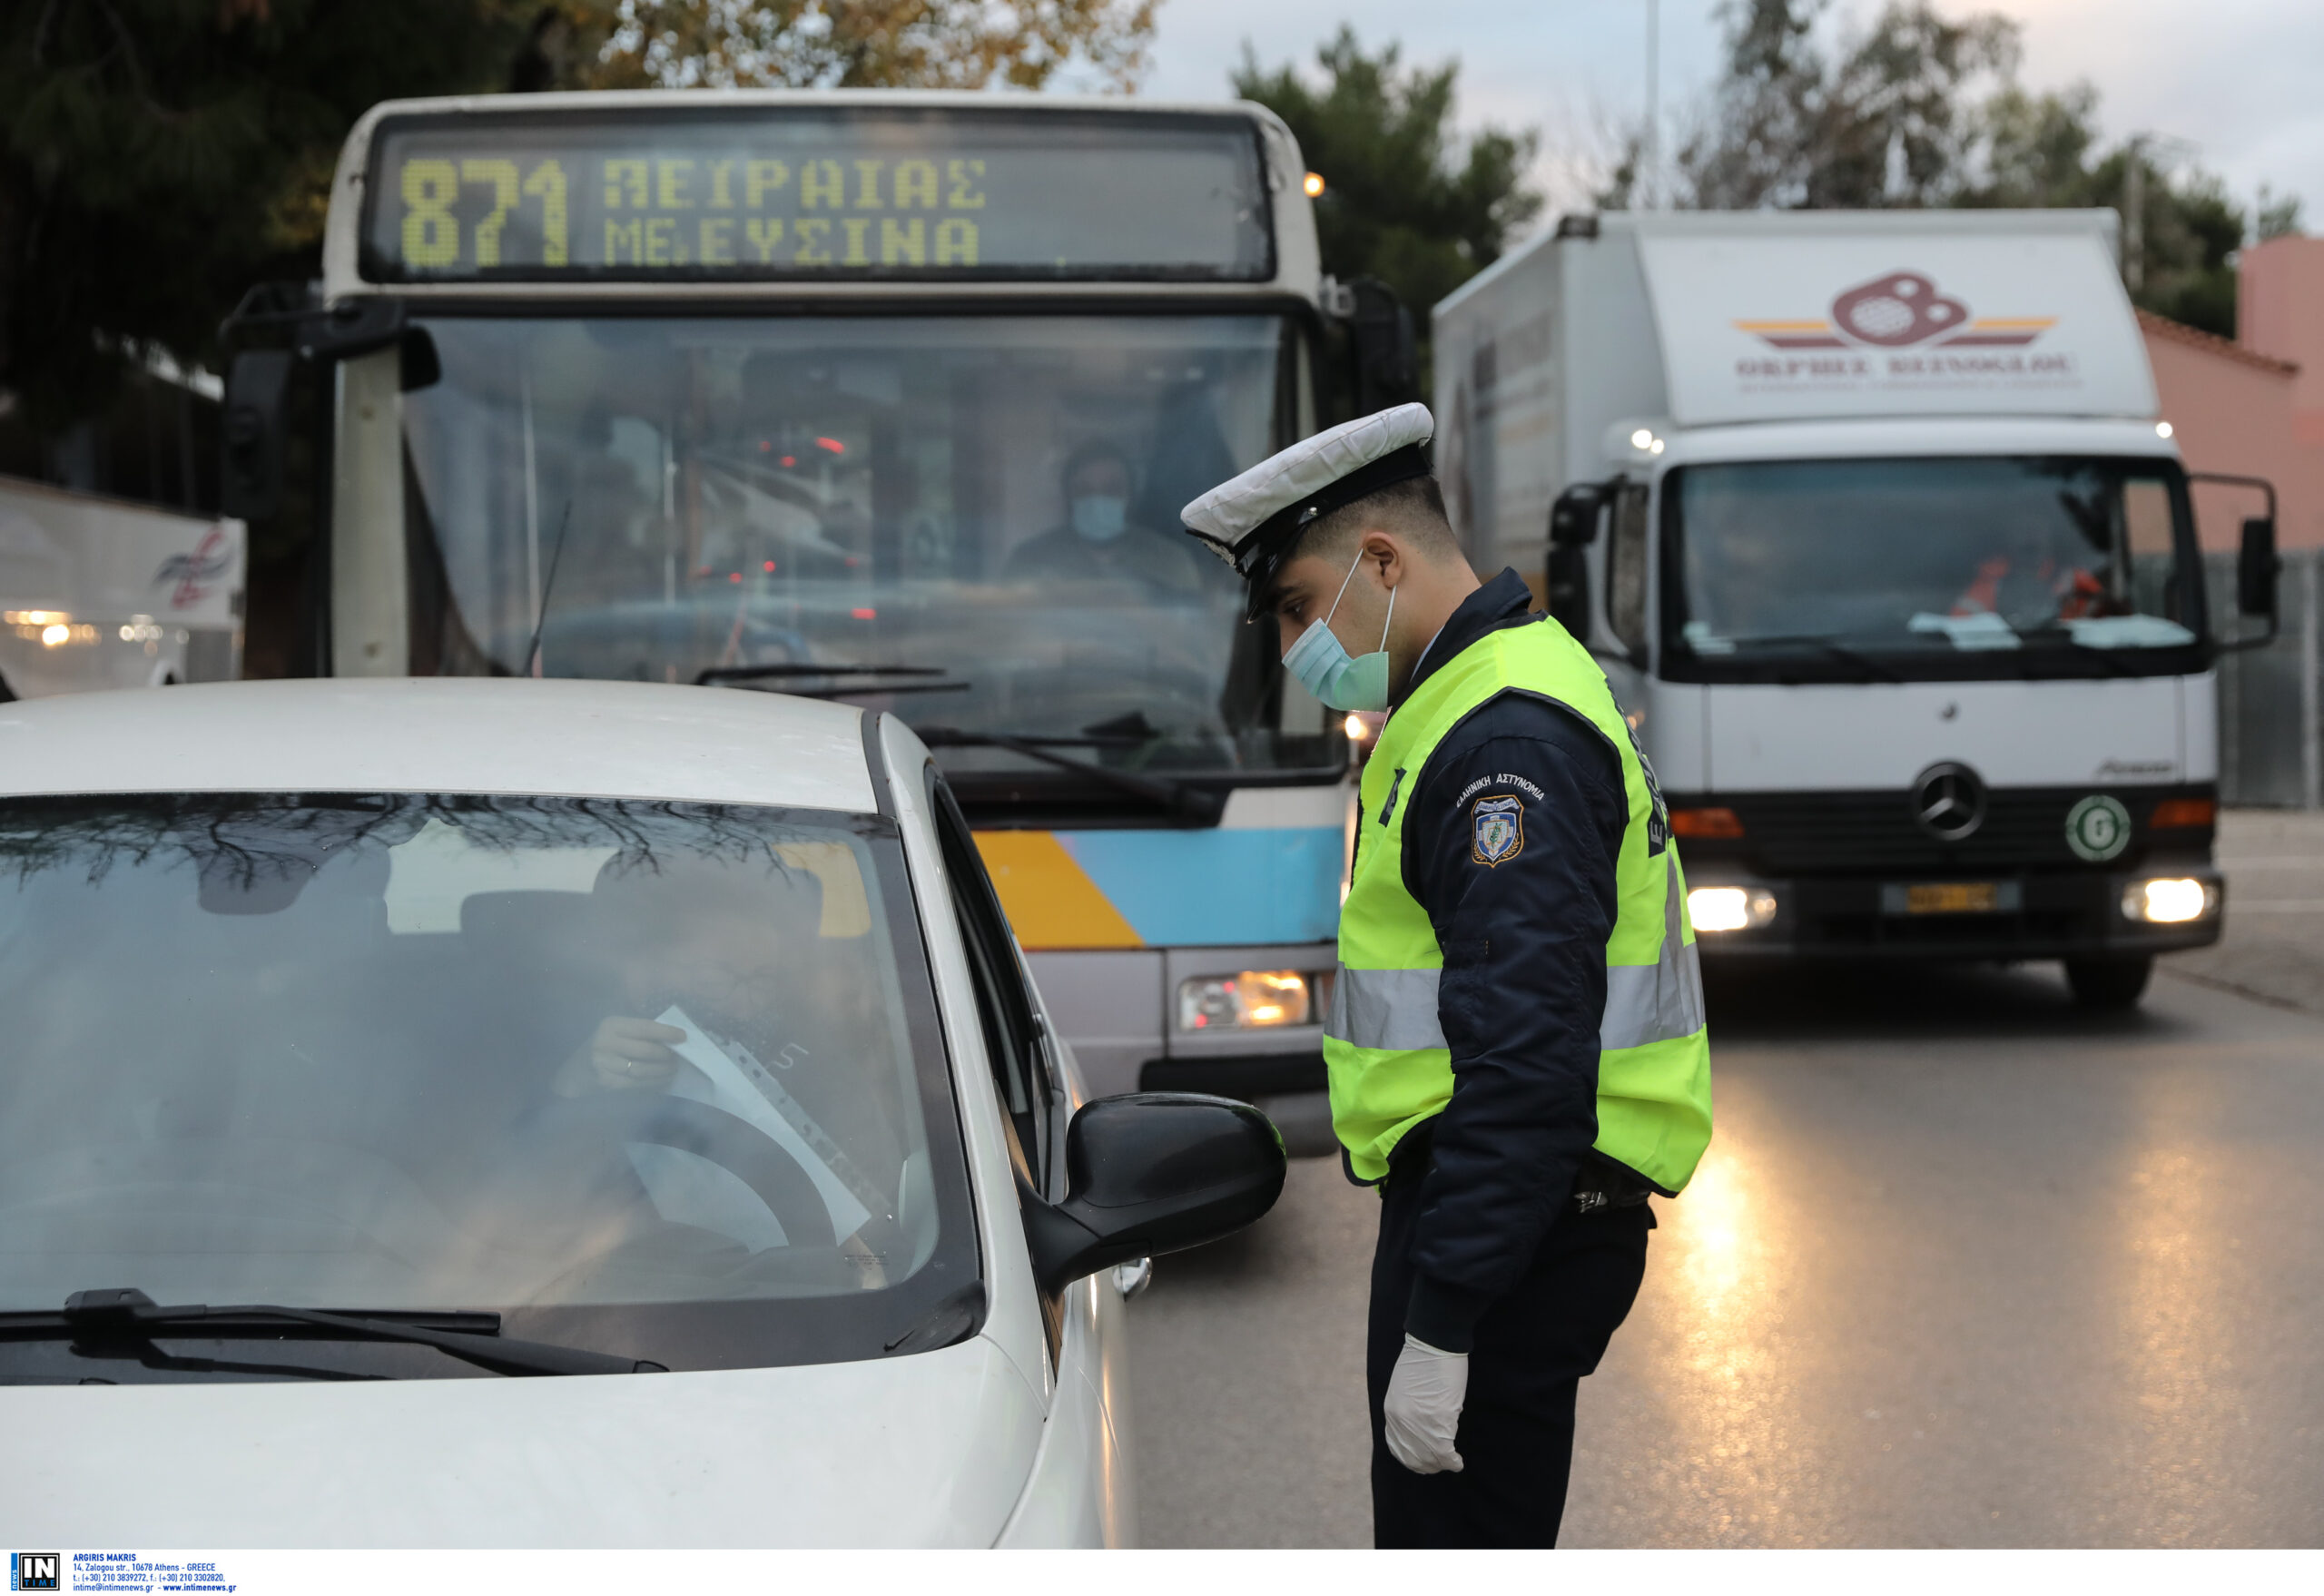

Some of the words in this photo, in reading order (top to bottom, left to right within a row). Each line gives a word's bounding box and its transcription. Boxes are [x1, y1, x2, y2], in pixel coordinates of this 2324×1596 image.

[401, 158, 568, 267] 871
[1456, 775, 1492, 808] ΕΛΛΗΝΙΚΗ
[1496, 773, 1545, 801] ΑΣΤΥΝΟΜΙΑ
